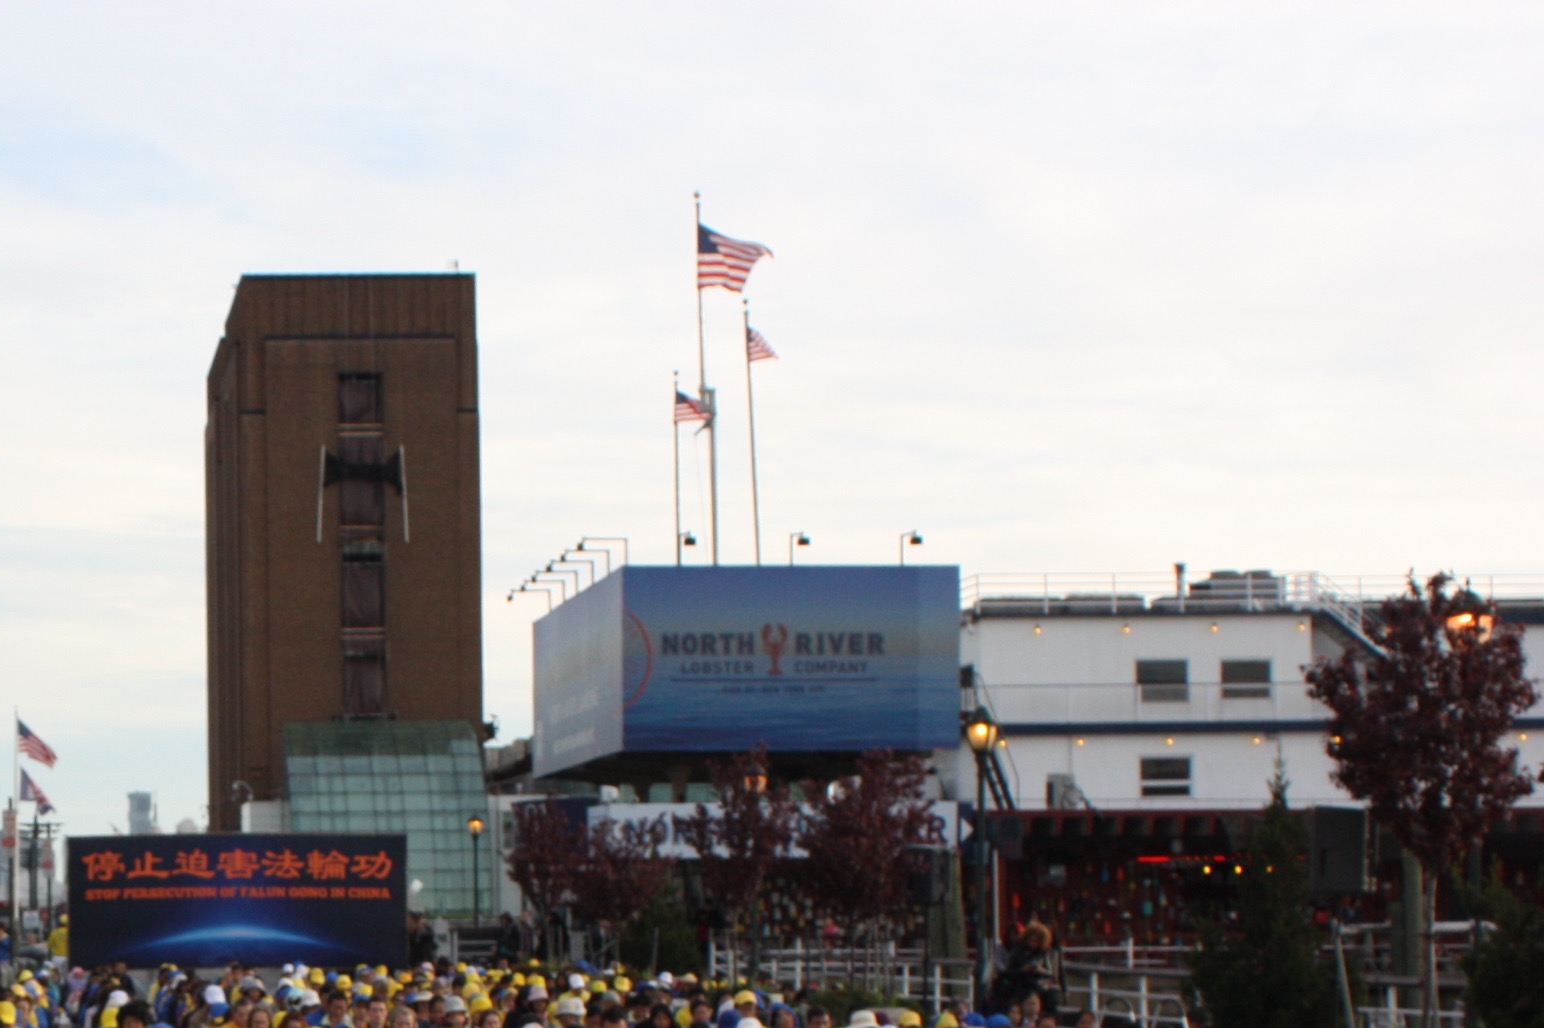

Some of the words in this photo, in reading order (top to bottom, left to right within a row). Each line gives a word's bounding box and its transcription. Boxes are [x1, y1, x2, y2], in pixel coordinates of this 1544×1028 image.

[661, 633, 754, 655] NORTH
[795, 633, 885, 655] RIVER
[681, 661, 754, 675] LOBSTER
[793, 660, 869, 674] COMPANY
[81, 849, 392, 881] 停止迫害法輪功
[86, 888, 120, 900] STOP
[123, 887, 217, 899] PERSECUTION
[220, 887, 237, 898] OF
[240, 887, 286, 898] FALUN
[289, 887, 328, 899] GONG
[331, 887, 347, 898] IN
[349, 887, 392, 899] CHINA
